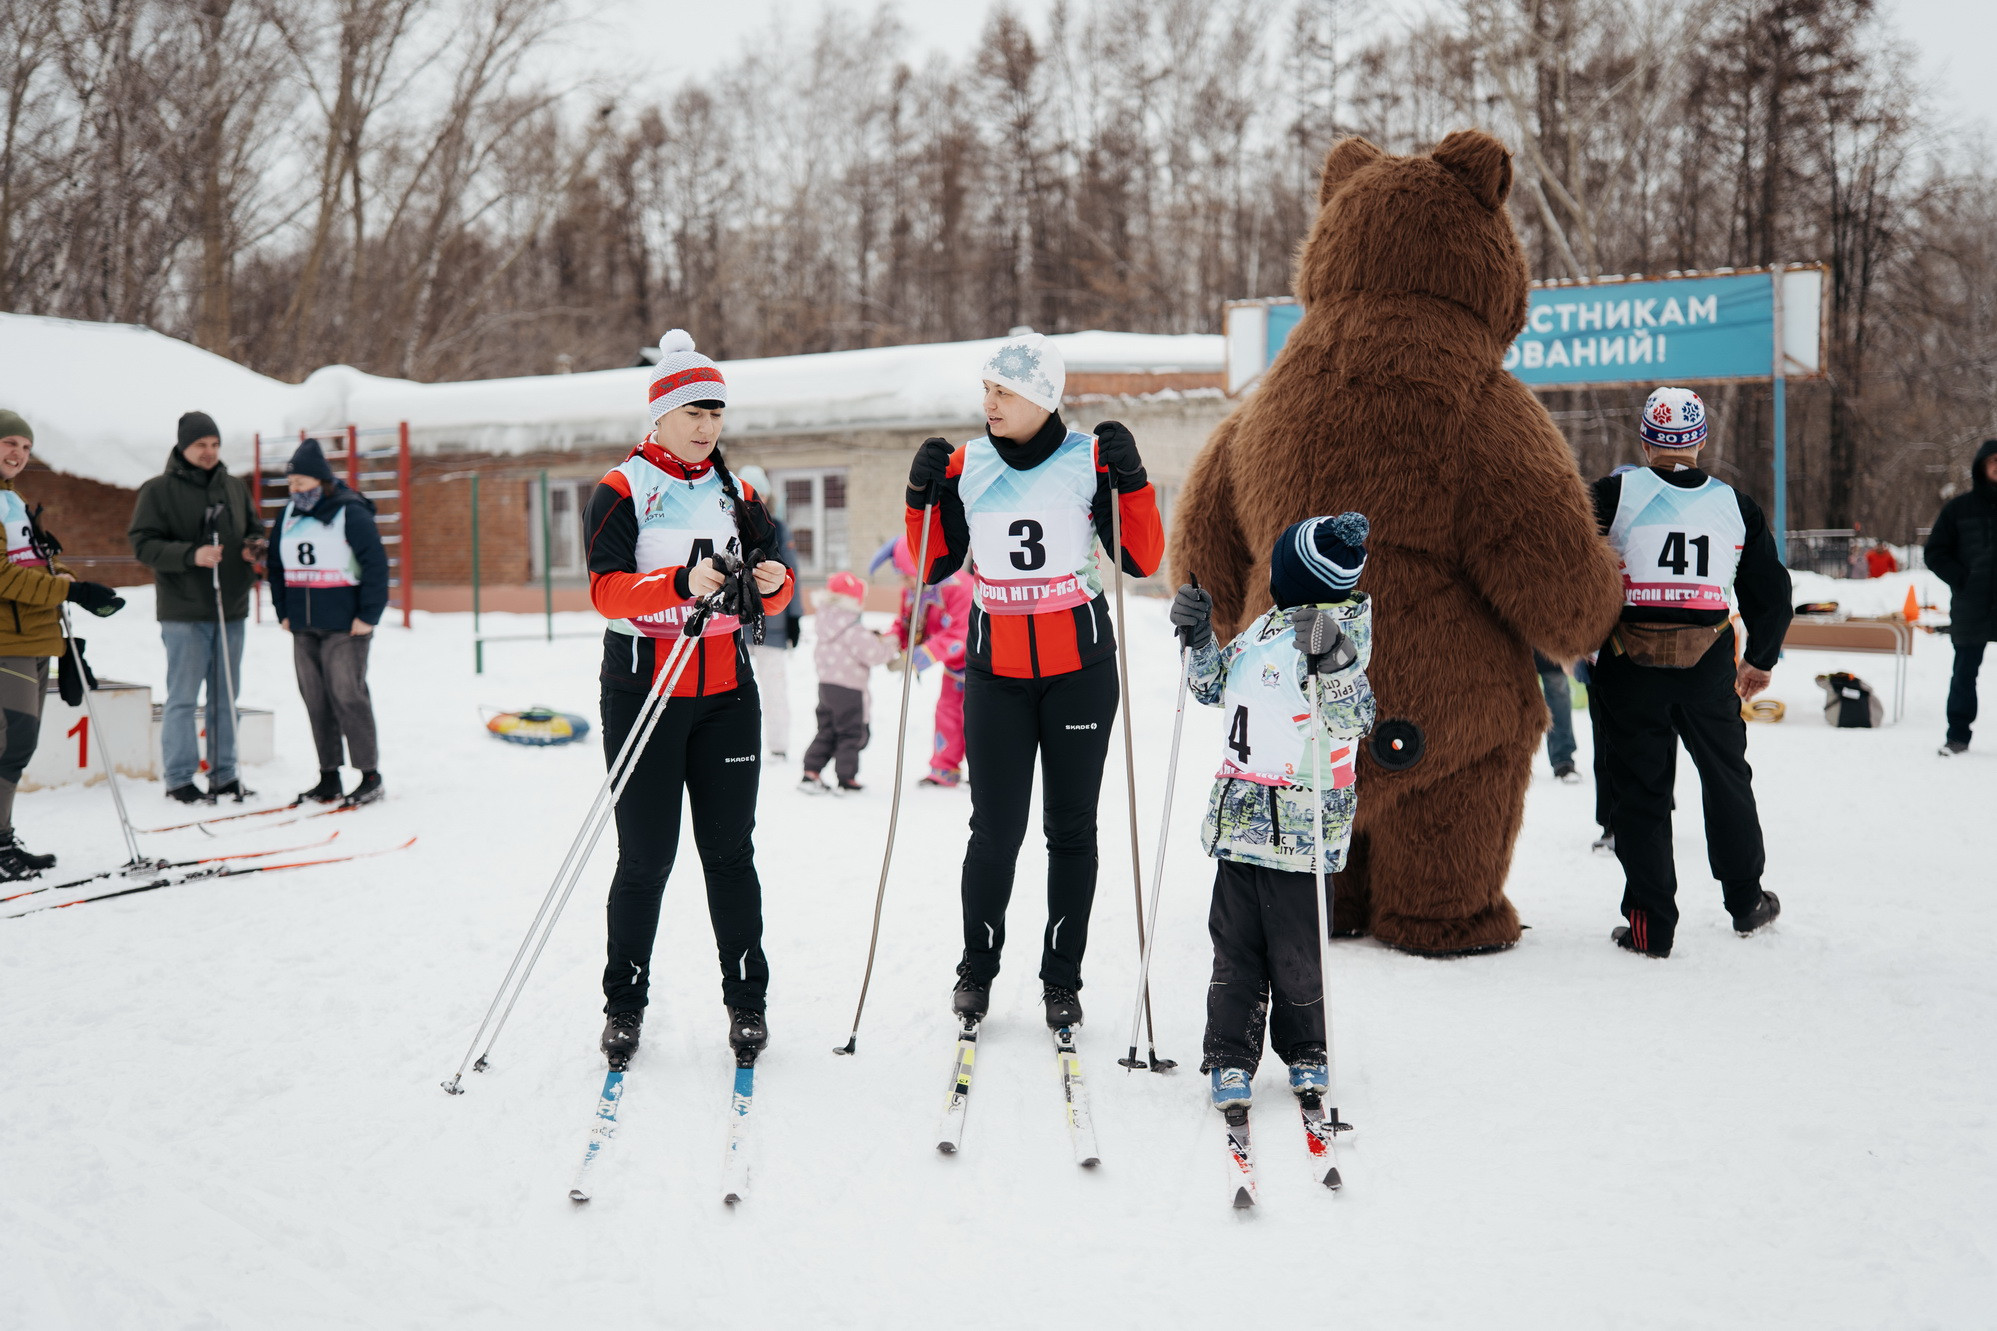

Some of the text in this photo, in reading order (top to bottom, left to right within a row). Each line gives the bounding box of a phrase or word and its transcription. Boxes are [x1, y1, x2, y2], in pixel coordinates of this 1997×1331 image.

[1523, 294, 1718, 334] СТНИКАМ
[297, 543, 316, 565] 8
[1008, 519, 1046, 571] 3
[1657, 531, 1709, 577] 41
[66, 715, 89, 768] 1
[1228, 704, 1251, 765] 4
[1285, 762, 1295, 775] 3
